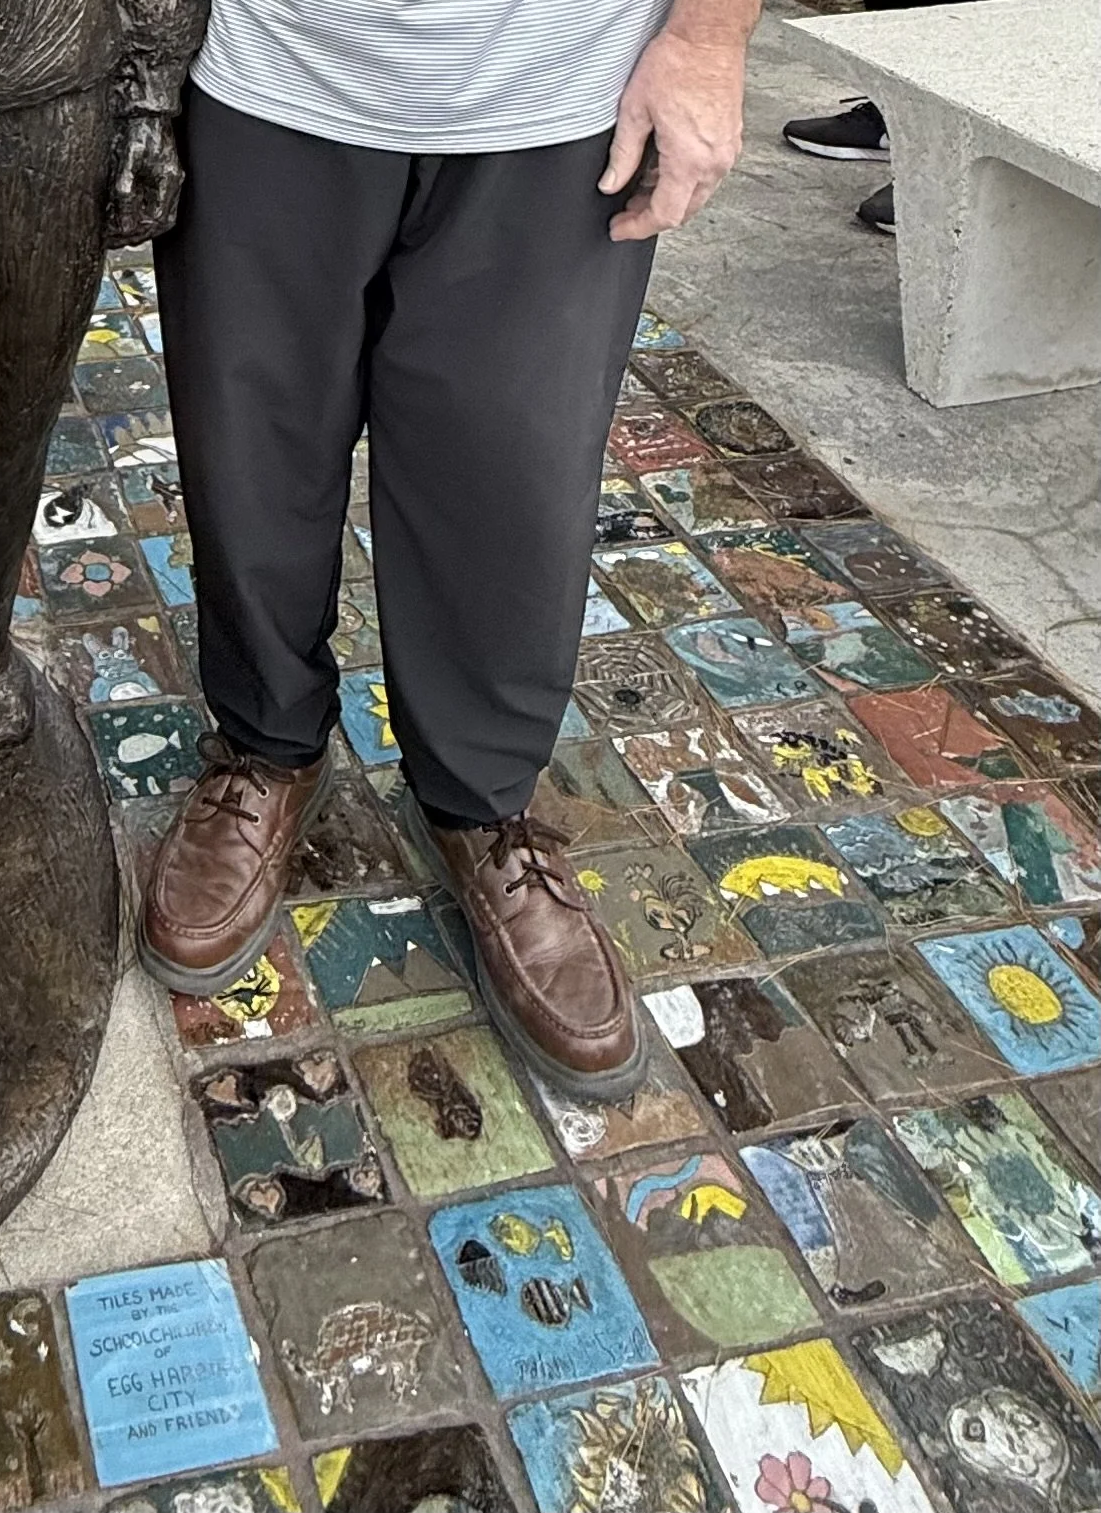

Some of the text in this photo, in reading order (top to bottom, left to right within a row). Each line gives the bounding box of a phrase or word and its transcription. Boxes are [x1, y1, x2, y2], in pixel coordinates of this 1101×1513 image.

[96, 1280, 197, 1312] TILES MADE
[130, 1302, 179, 1322] BY THE
[89, 1319, 228, 1358] SCHOOLCHDREN
[153, 1344, 172, 1359] OF
[107, 1371, 144, 1399] EGG
[147, 1388, 197, 1413] CITY
[127, 1420, 158, 1442] AND
